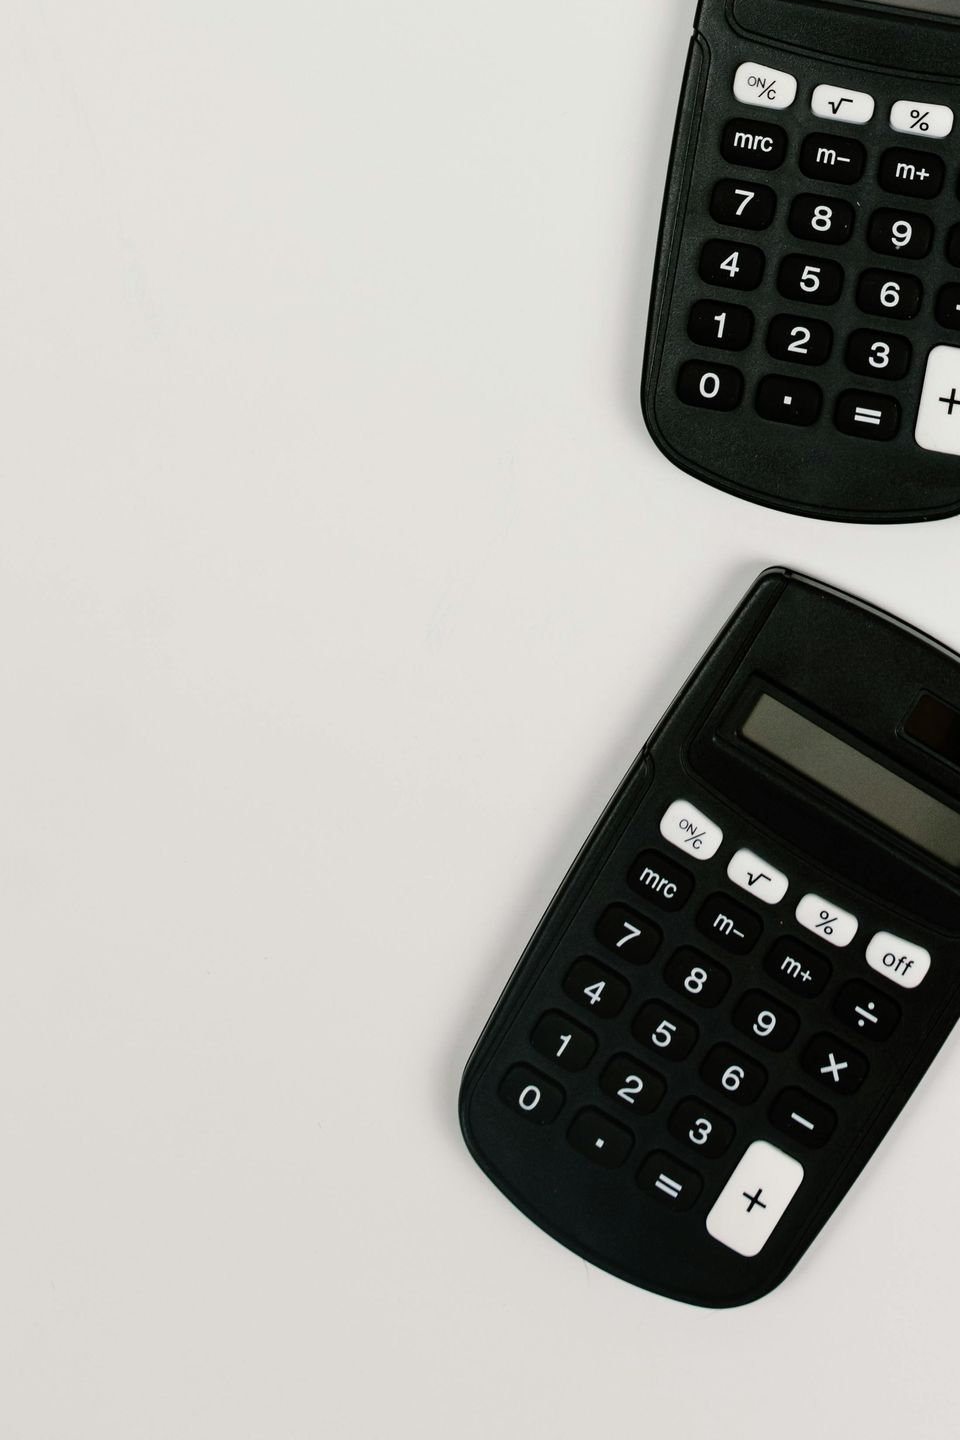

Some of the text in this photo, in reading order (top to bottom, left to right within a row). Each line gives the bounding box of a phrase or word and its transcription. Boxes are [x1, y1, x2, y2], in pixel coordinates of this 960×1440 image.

[733, 131, 774, 153] mrc
[895, 162, 930, 181] m+
[734, 188, 755, 216] 7
[811, 205, 833, 232] 8
[891, 220, 913, 248] 9
[719, 251, 740, 278] 4
[799, 265, 821, 293] 5
[879, 281, 901, 308] 6
[714, 312, 727, 339] 1
[787, 326, 811, 354] 2
[868, 341, 890, 369] 3
[699, 372, 720, 399] 0
[639, 867, 677, 899] mrc
[780, 956, 812, 982] m+
[616, 921, 642, 948] 7
[683, 967, 708, 994] 8
[752, 1010, 777, 1037] 9
[882, 952, 915, 977] off
[583, 981, 606, 1005] 4
[651, 1019, 677, 1048] 5
[721, 1065, 745, 1091] 6
[518, 1085, 541, 1111] 0
[556, 1034, 572, 1057] 1
[617, 1074, 644, 1104] 2
[688, 1118, 713, 1145] 3
